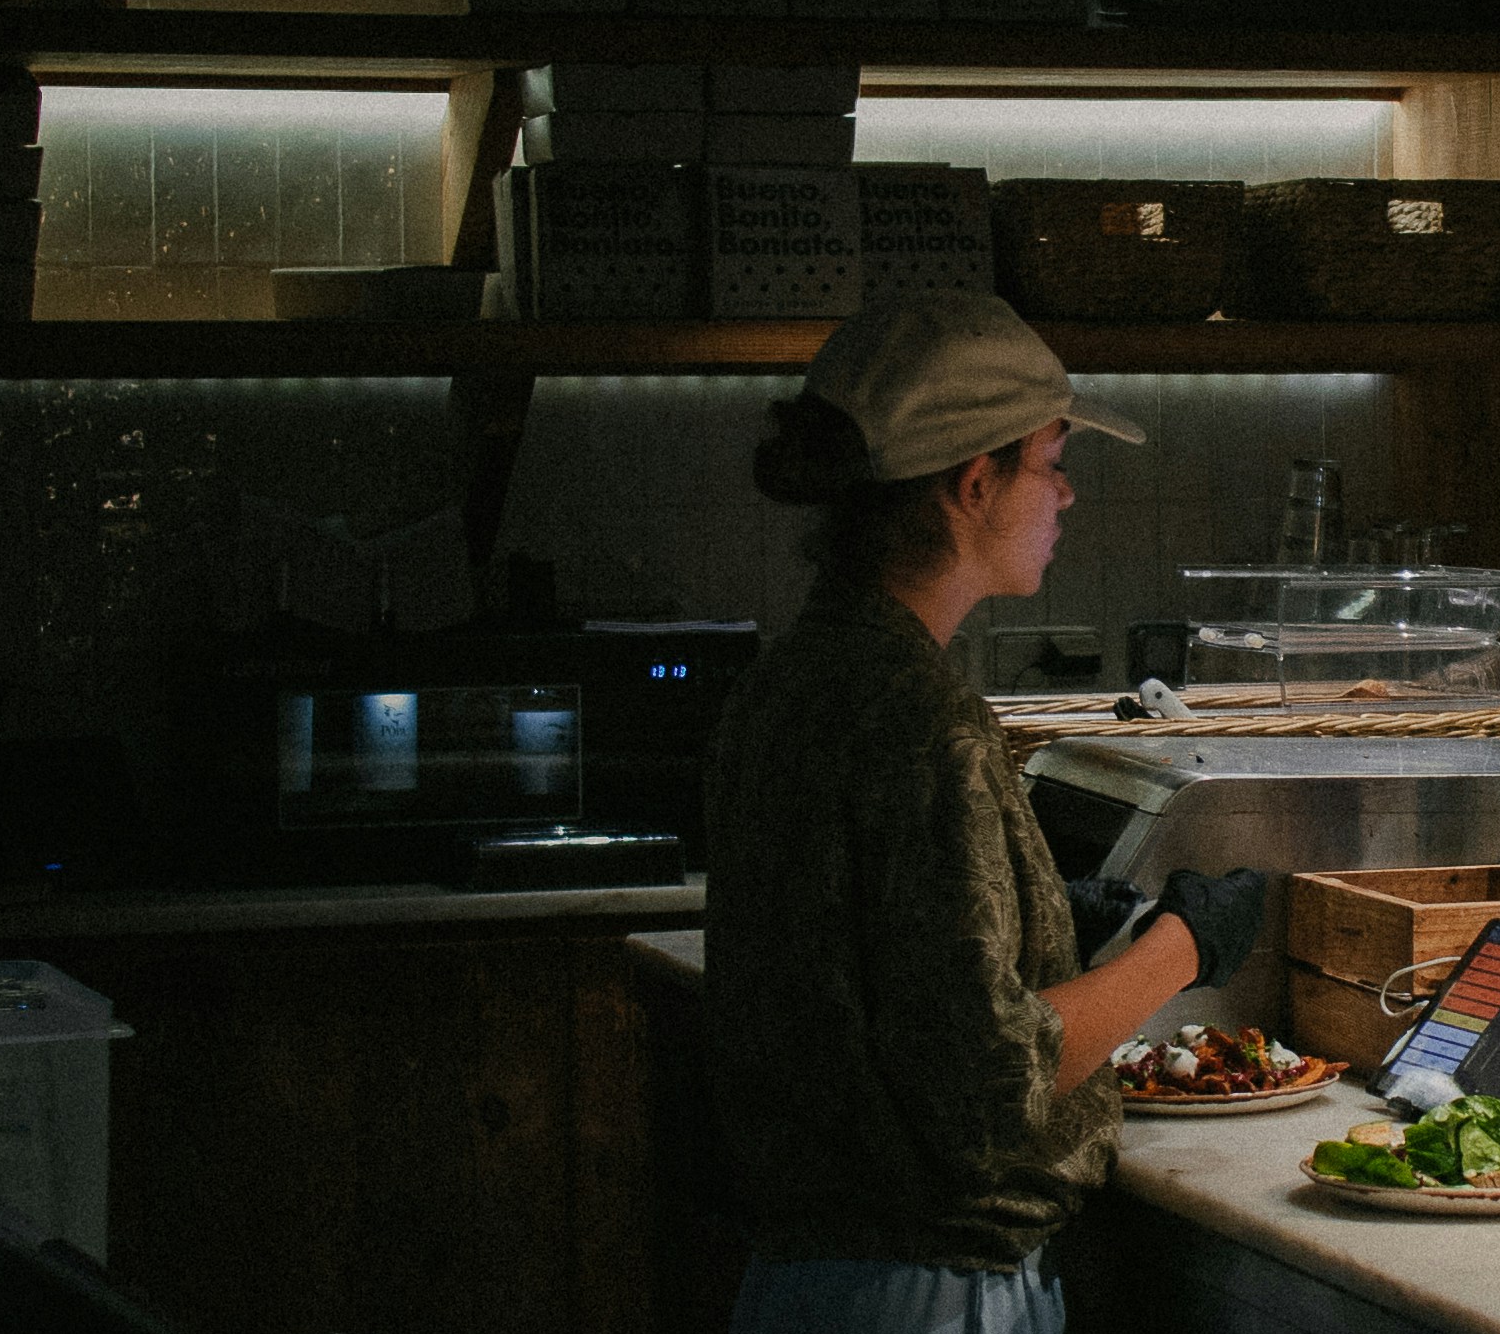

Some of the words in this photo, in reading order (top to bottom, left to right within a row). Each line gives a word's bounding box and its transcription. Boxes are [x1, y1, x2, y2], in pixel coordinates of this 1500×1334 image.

[716, 176, 828, 204] Bueno,
[717, 202, 831, 231] Bonito,
[718, 229, 855, 257] Boniato.
